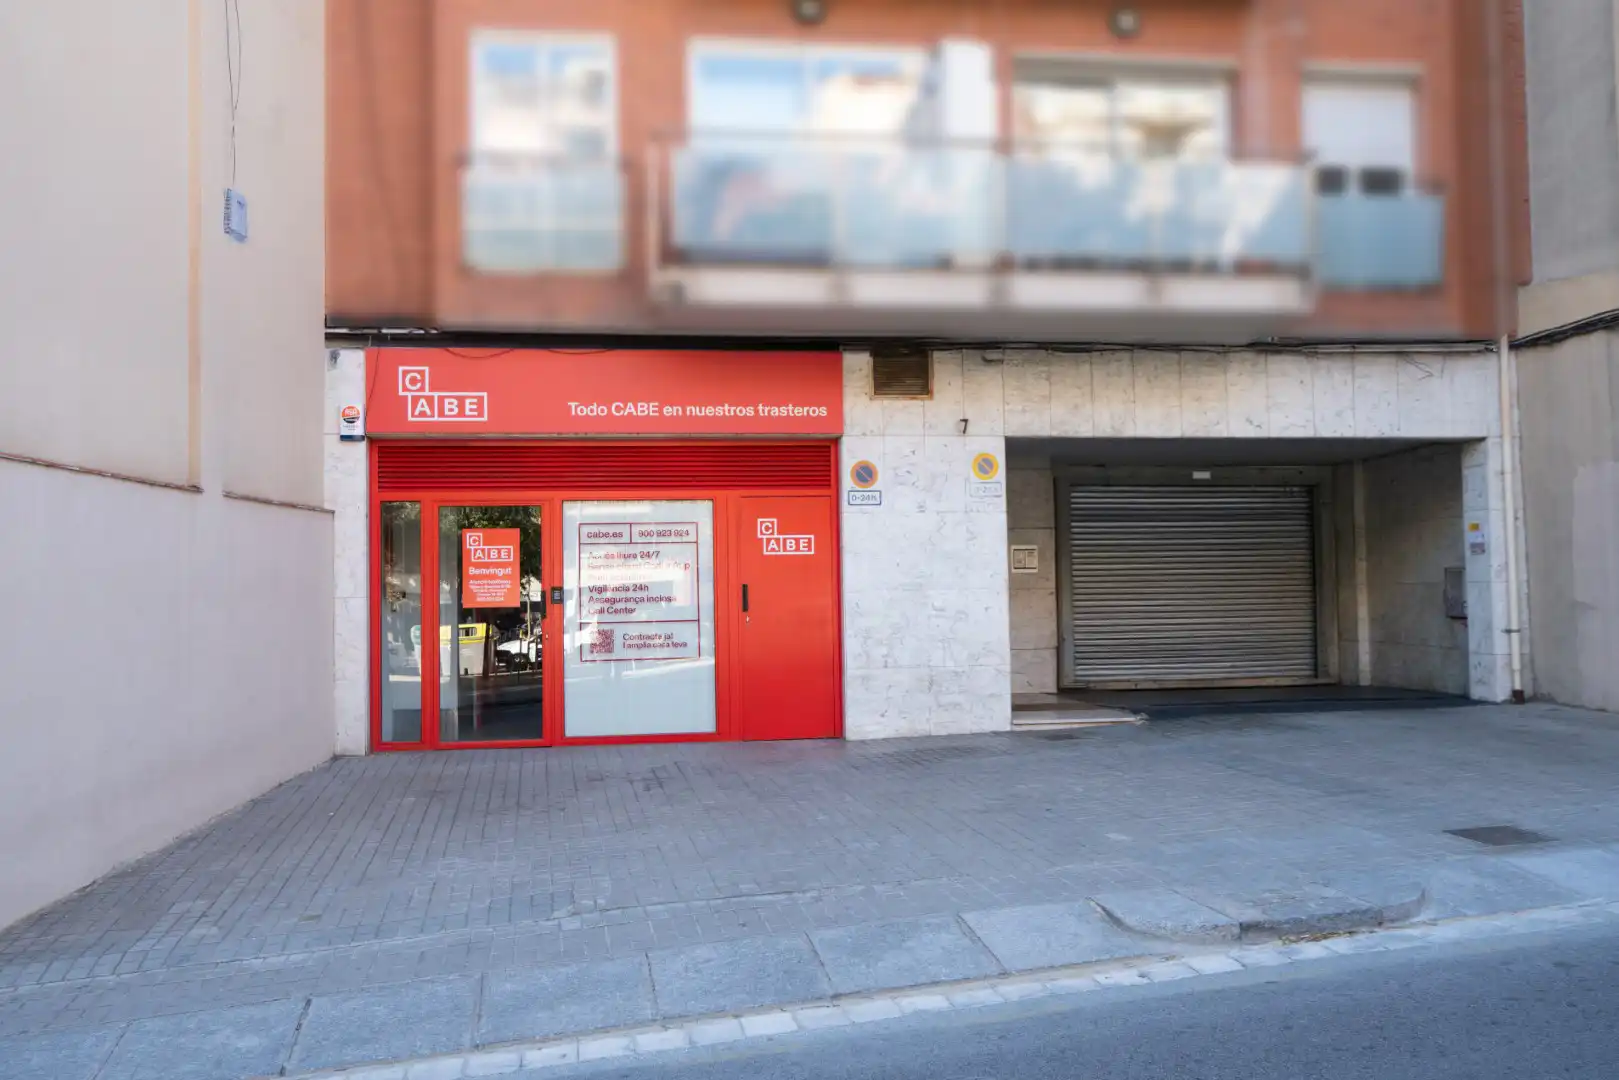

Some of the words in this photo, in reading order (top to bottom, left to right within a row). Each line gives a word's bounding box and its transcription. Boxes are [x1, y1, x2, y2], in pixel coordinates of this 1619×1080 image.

[568, 402, 607, 416] Todo
[611, 402, 659, 416] CABE
[663, 405, 682, 416] en
[686, 403, 754, 416] nuestros
[758, 403, 827, 416] trasteros
[959, 418, 969, 434] 7
[586, 529, 624, 538] cabe.es
[638, 529, 655, 538] 900
[639, 550, 661, 559] 24/7
[631, 583, 649, 592] 24h
[606, 606, 637, 614] Center
